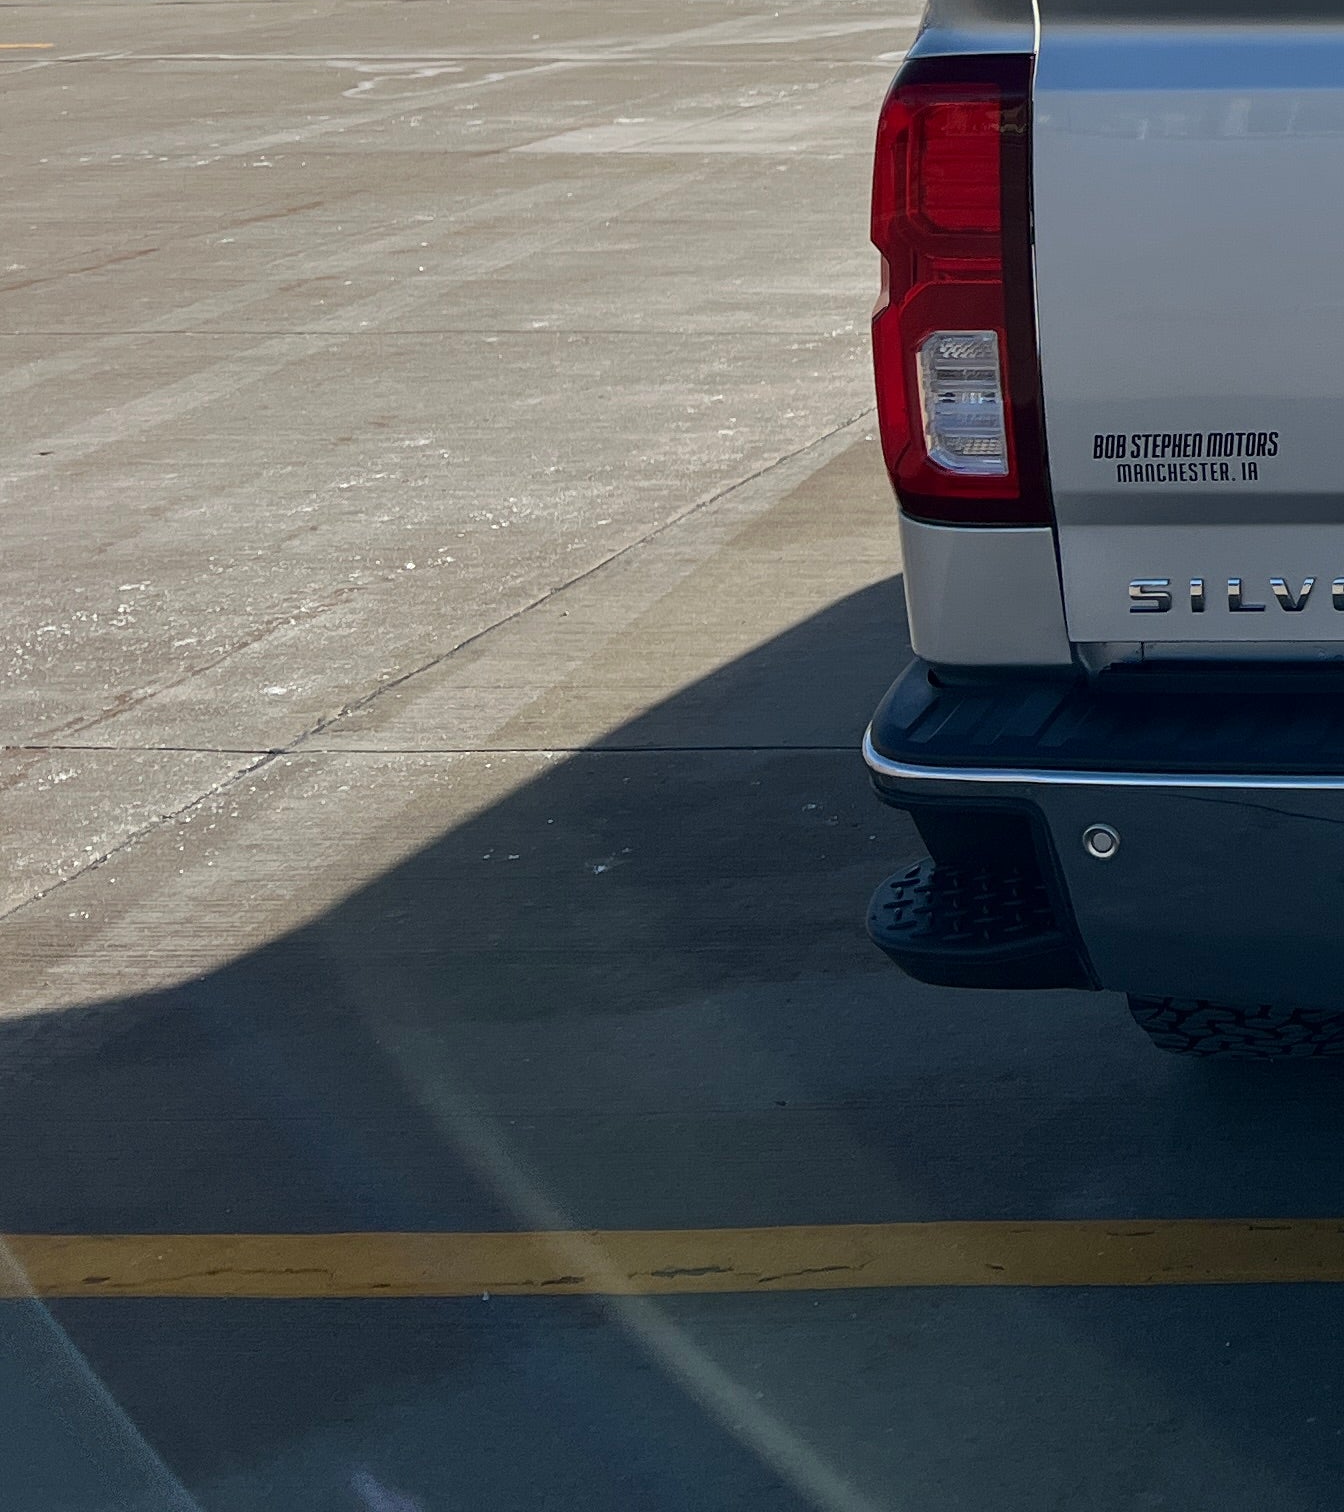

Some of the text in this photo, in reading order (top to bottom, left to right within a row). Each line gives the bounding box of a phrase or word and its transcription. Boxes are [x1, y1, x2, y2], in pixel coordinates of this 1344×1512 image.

[1093, 432, 1279, 459] BOB STEPHEN MOTORS
[1241, 462, 1258, 481] IA
